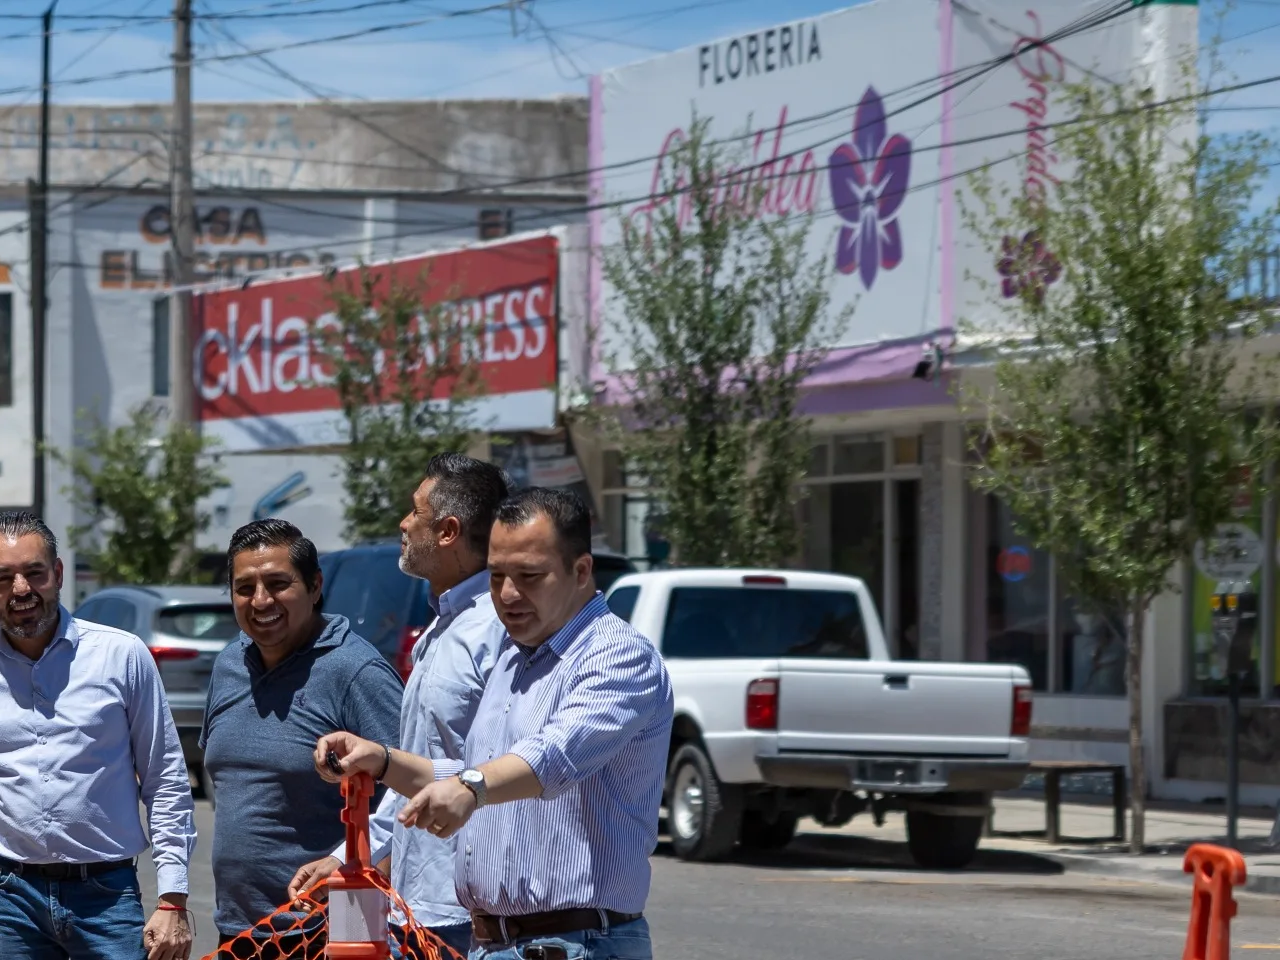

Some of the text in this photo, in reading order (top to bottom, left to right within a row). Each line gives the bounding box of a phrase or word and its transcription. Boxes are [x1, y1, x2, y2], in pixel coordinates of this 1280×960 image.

[699, 21, 823, 87] FLORERIA
[100, 250, 338, 289] ELCTRI
[398, 285, 548, 373] XPRESS
